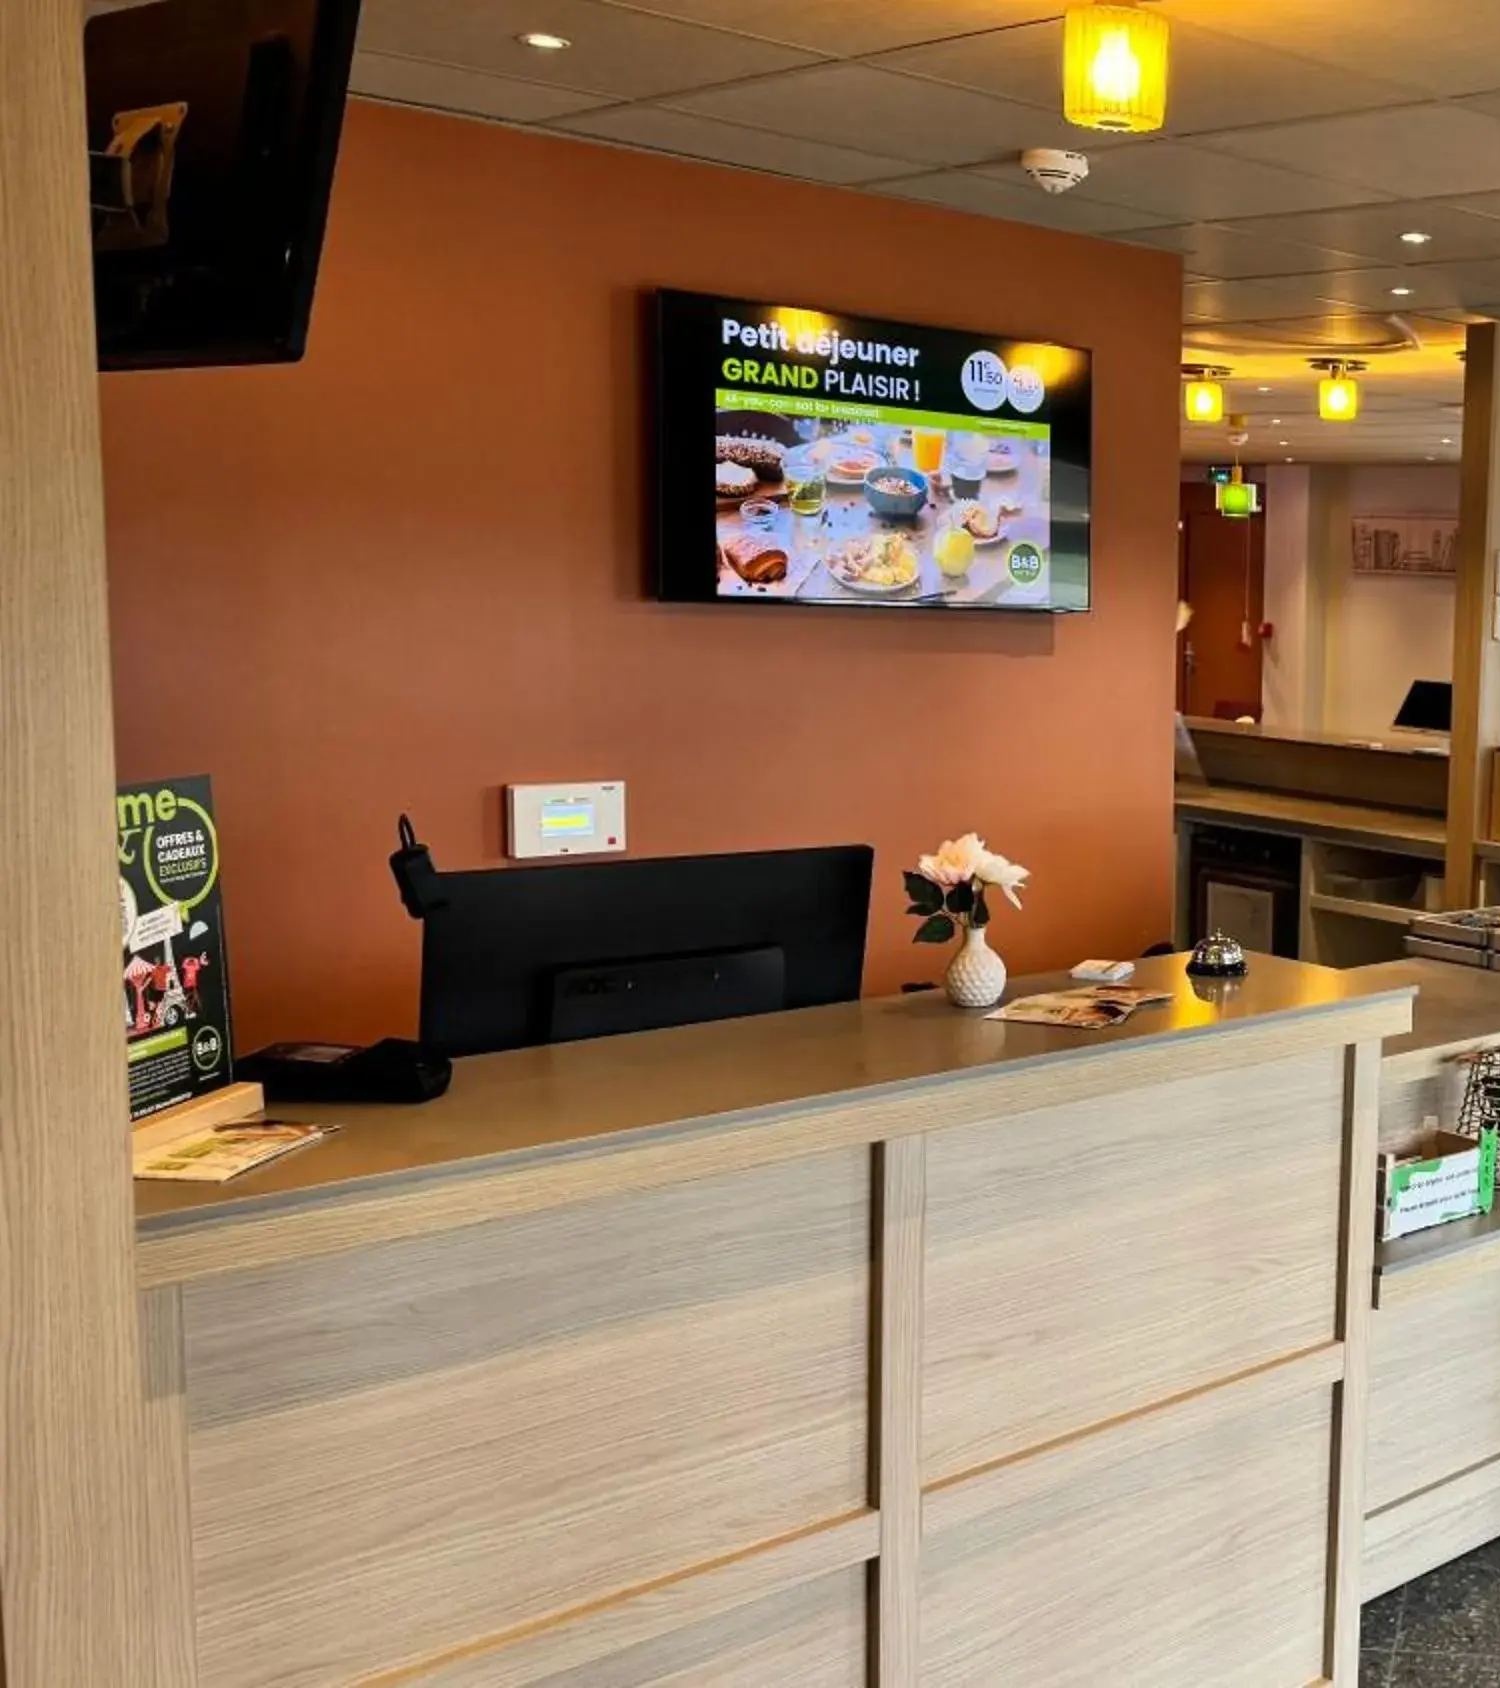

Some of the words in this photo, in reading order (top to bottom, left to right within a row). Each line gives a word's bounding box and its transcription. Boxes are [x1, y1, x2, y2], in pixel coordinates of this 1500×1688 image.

[721, 317, 790, 352] Petit
[795, 326, 920, 368] déjeuner
[721, 357, 819, 390] GRAND
[824, 368, 910, 401] PLAISIR
[155, 831, 195, 849] OFFRES
[157, 844, 206, 863] CADEAUX
